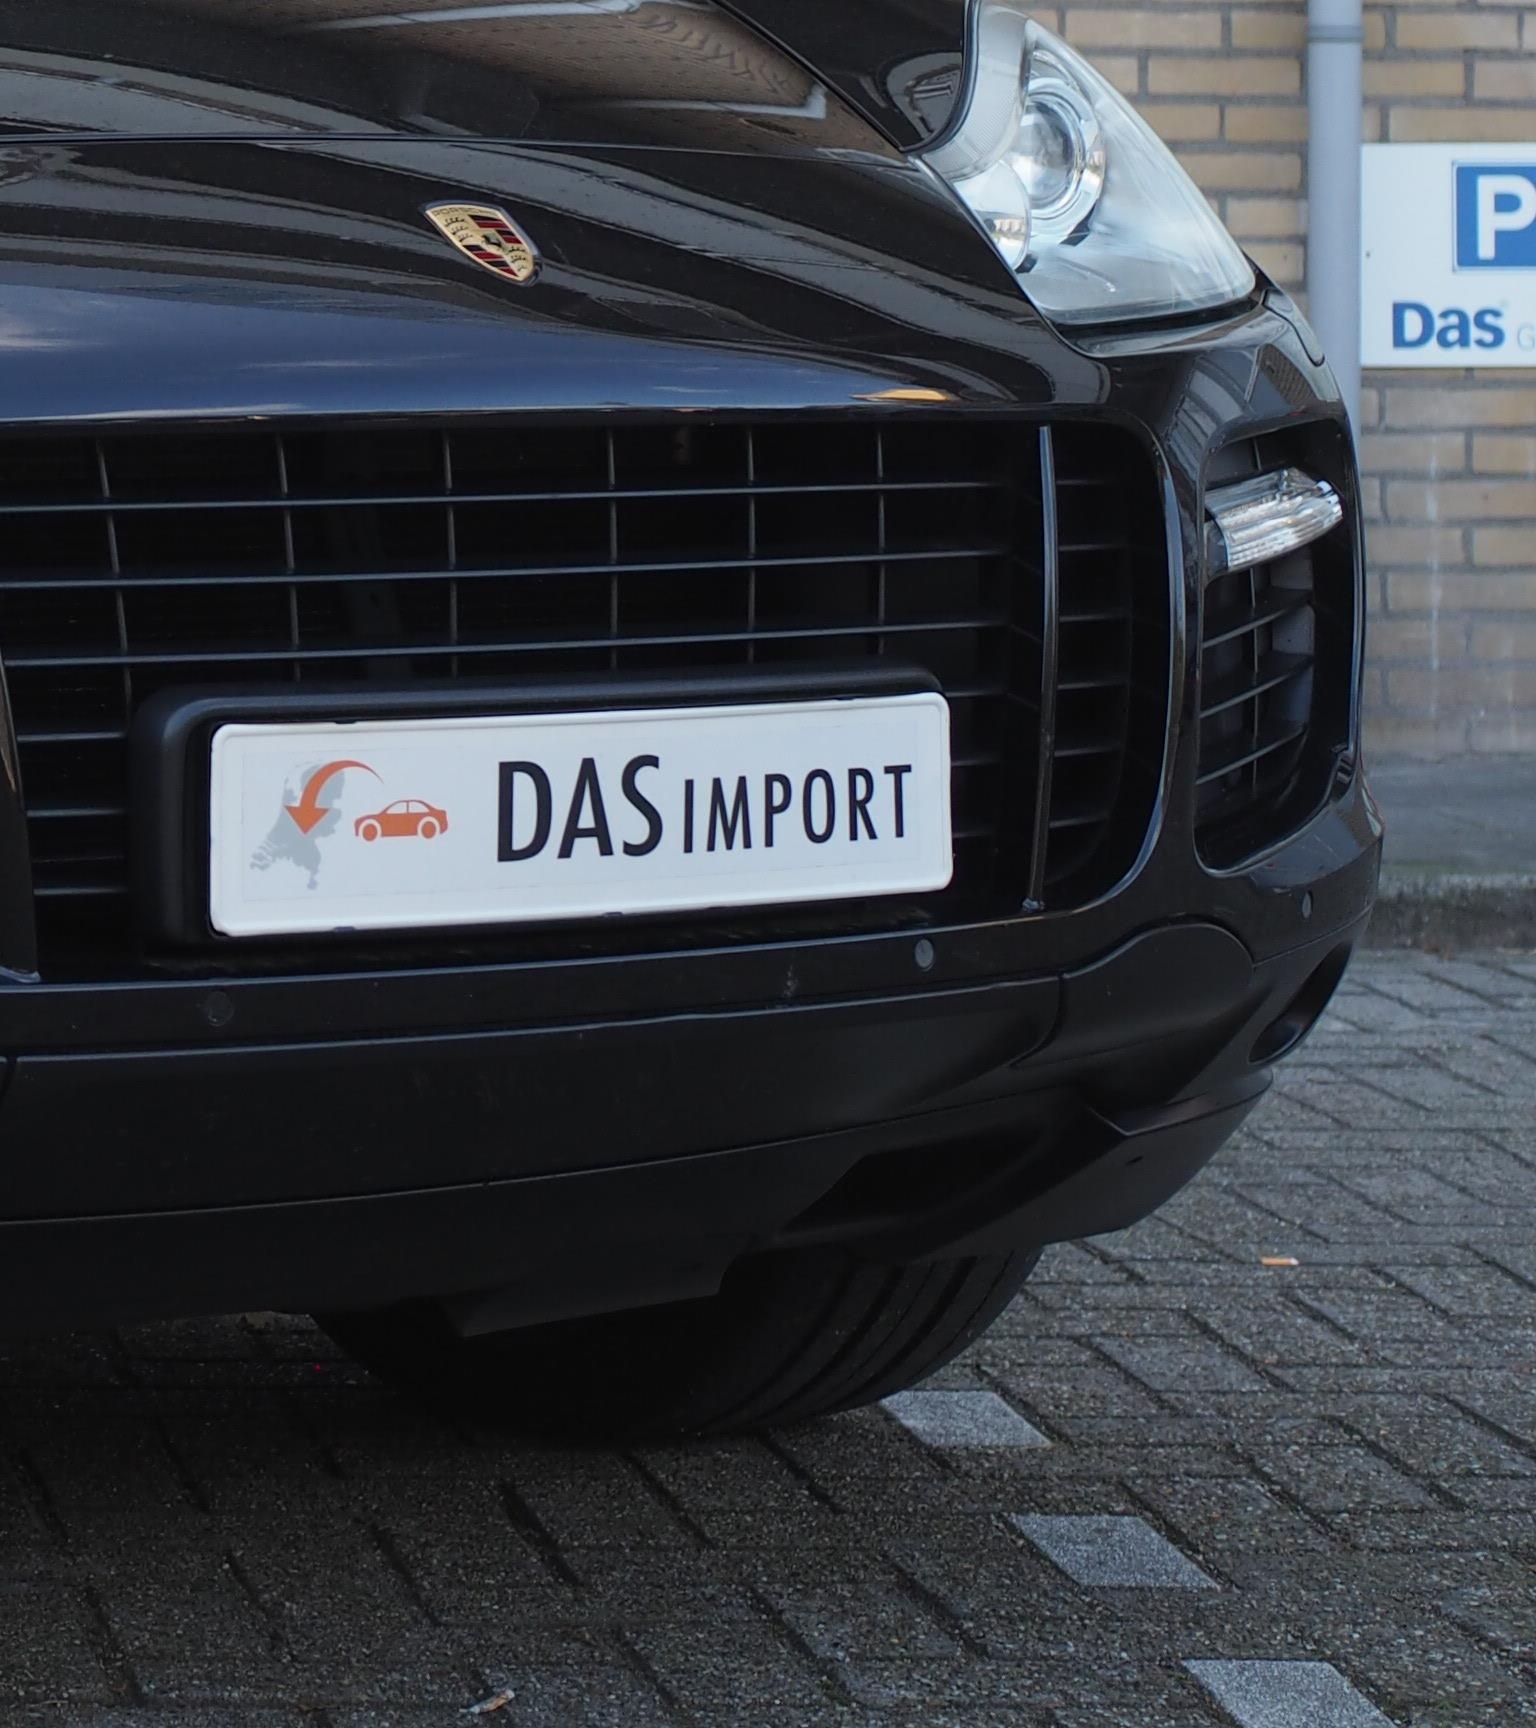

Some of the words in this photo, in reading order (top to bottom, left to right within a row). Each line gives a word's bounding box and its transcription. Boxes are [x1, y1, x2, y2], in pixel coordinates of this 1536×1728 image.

[1477, 175, 1536, 260] P
[496, 754, 664, 865] DAS
[683, 763, 913, 856] IMPORT
